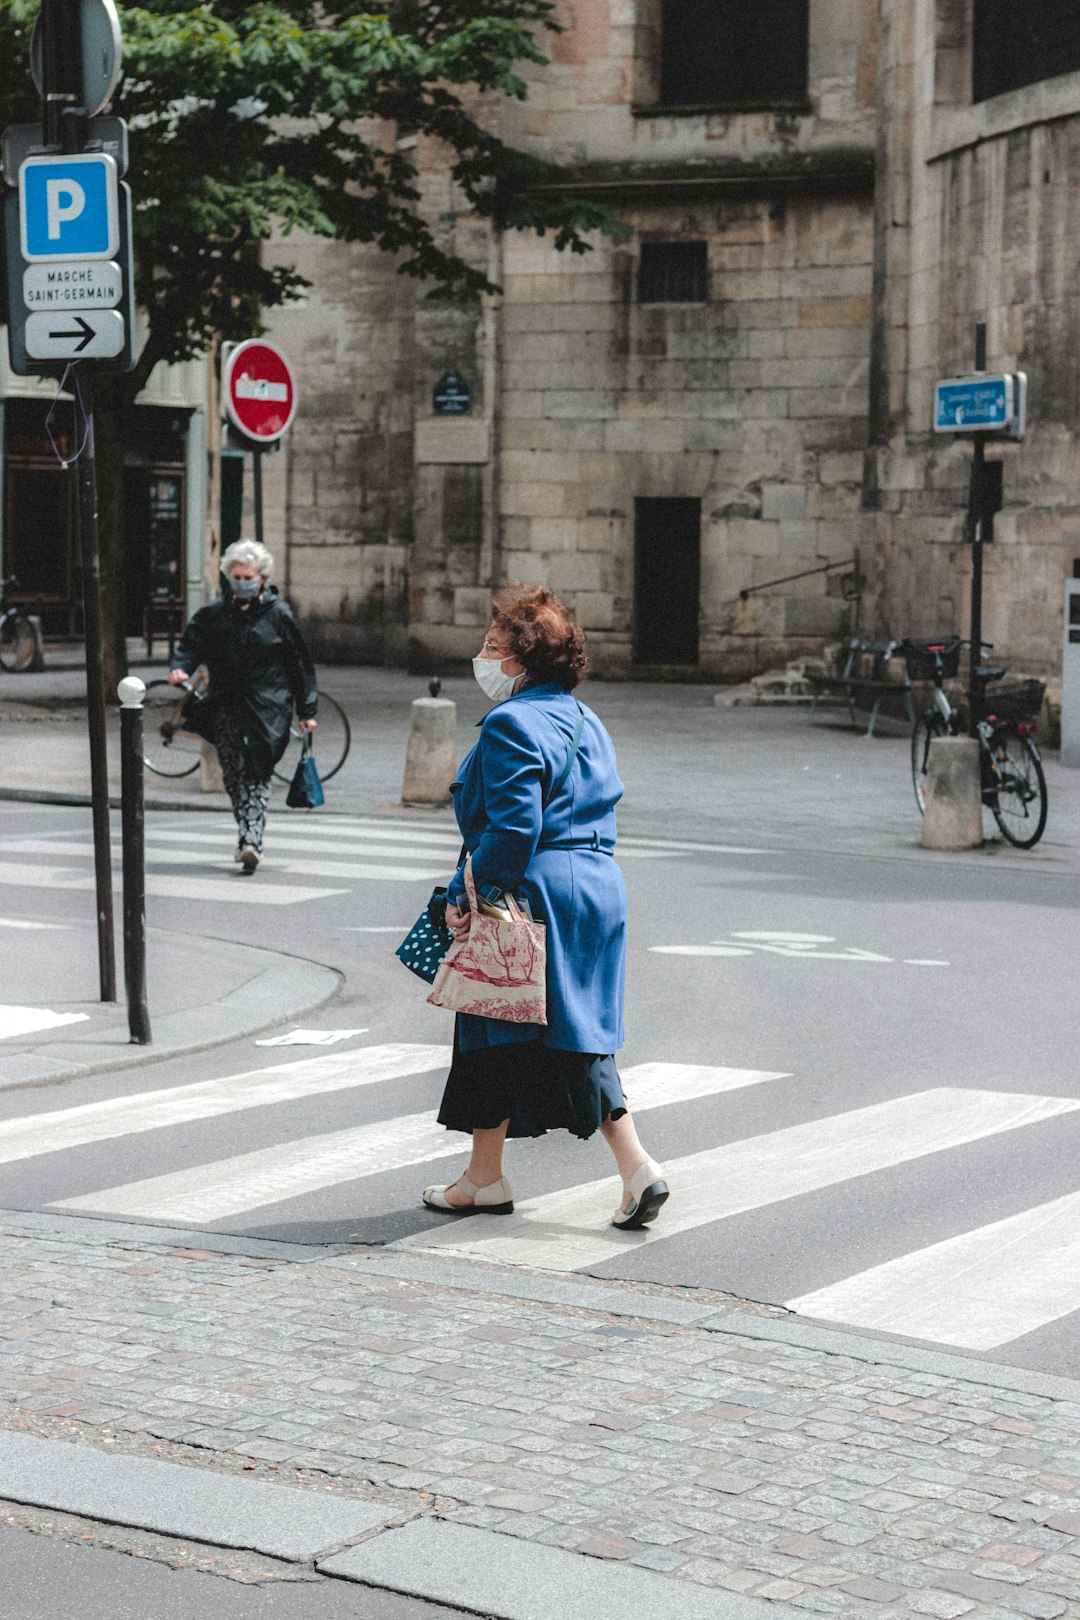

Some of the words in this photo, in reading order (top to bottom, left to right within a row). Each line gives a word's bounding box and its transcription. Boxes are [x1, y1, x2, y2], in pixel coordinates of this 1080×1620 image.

[46, 178, 86, 240] P
[47, 269, 93, 283] MARCHÉ
[28, 287, 115, 302] SAINT-GERMAIN
